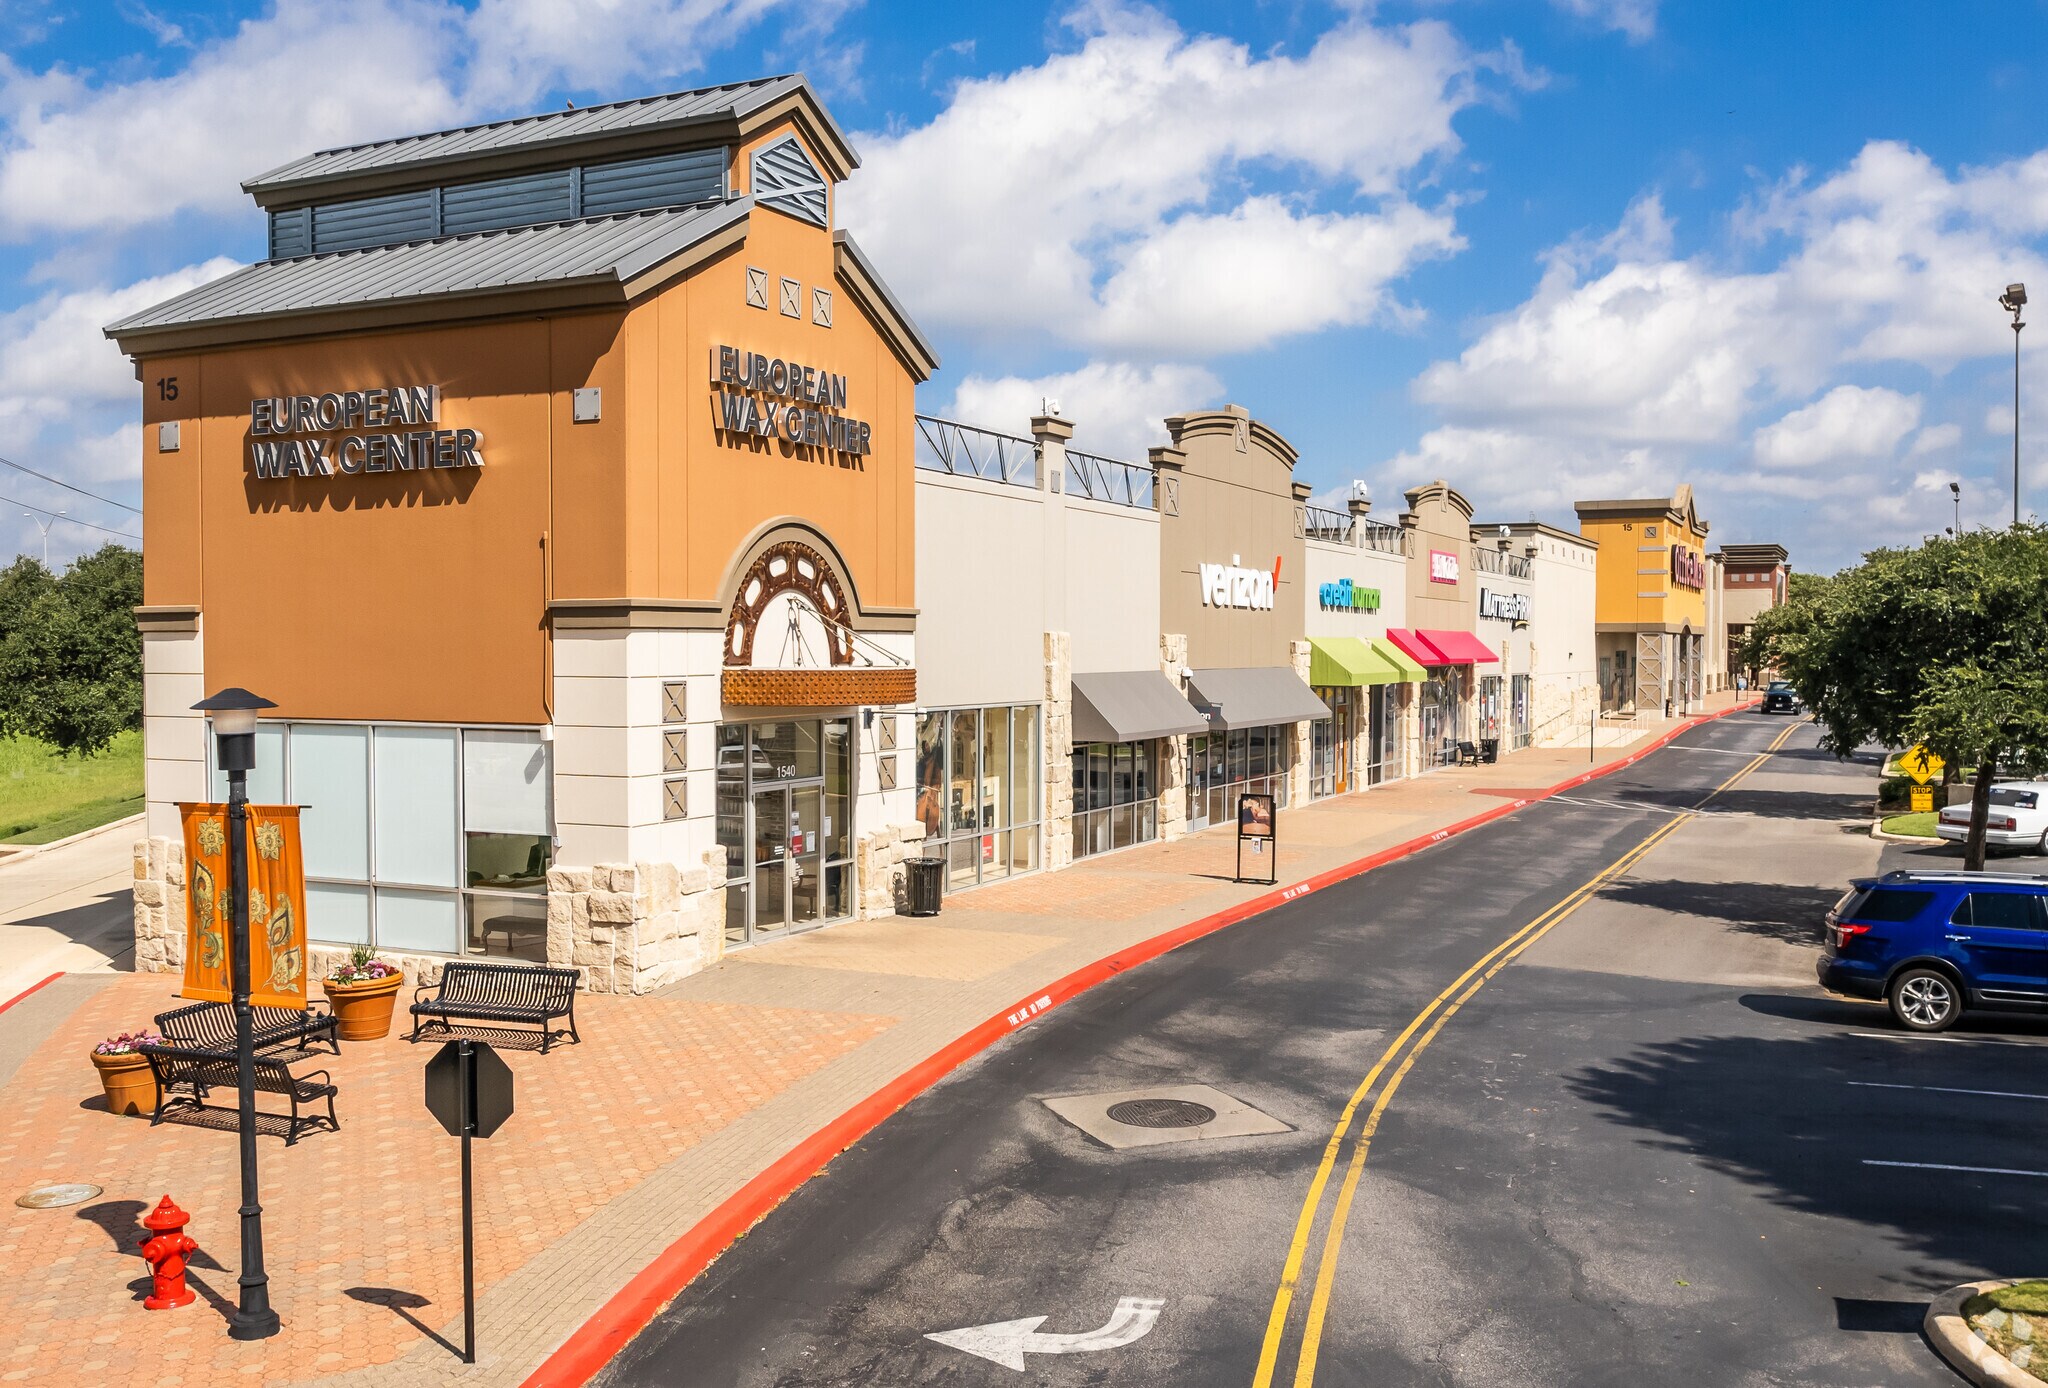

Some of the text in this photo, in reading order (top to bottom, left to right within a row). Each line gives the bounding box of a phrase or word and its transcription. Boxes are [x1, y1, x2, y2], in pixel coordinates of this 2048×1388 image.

[157, 377, 179, 401] 15
[713, 345, 847, 409] EUROPEAN
[251, 384, 440, 436] EUROPEAN
[718, 391, 872, 455] WAX CENTER
[252, 428, 485, 479] WAX CENTER
[1623, 523, 1633, 532] 15
[1199, 554, 1274, 609] verizon
[776, 764, 796, 778] 1540
